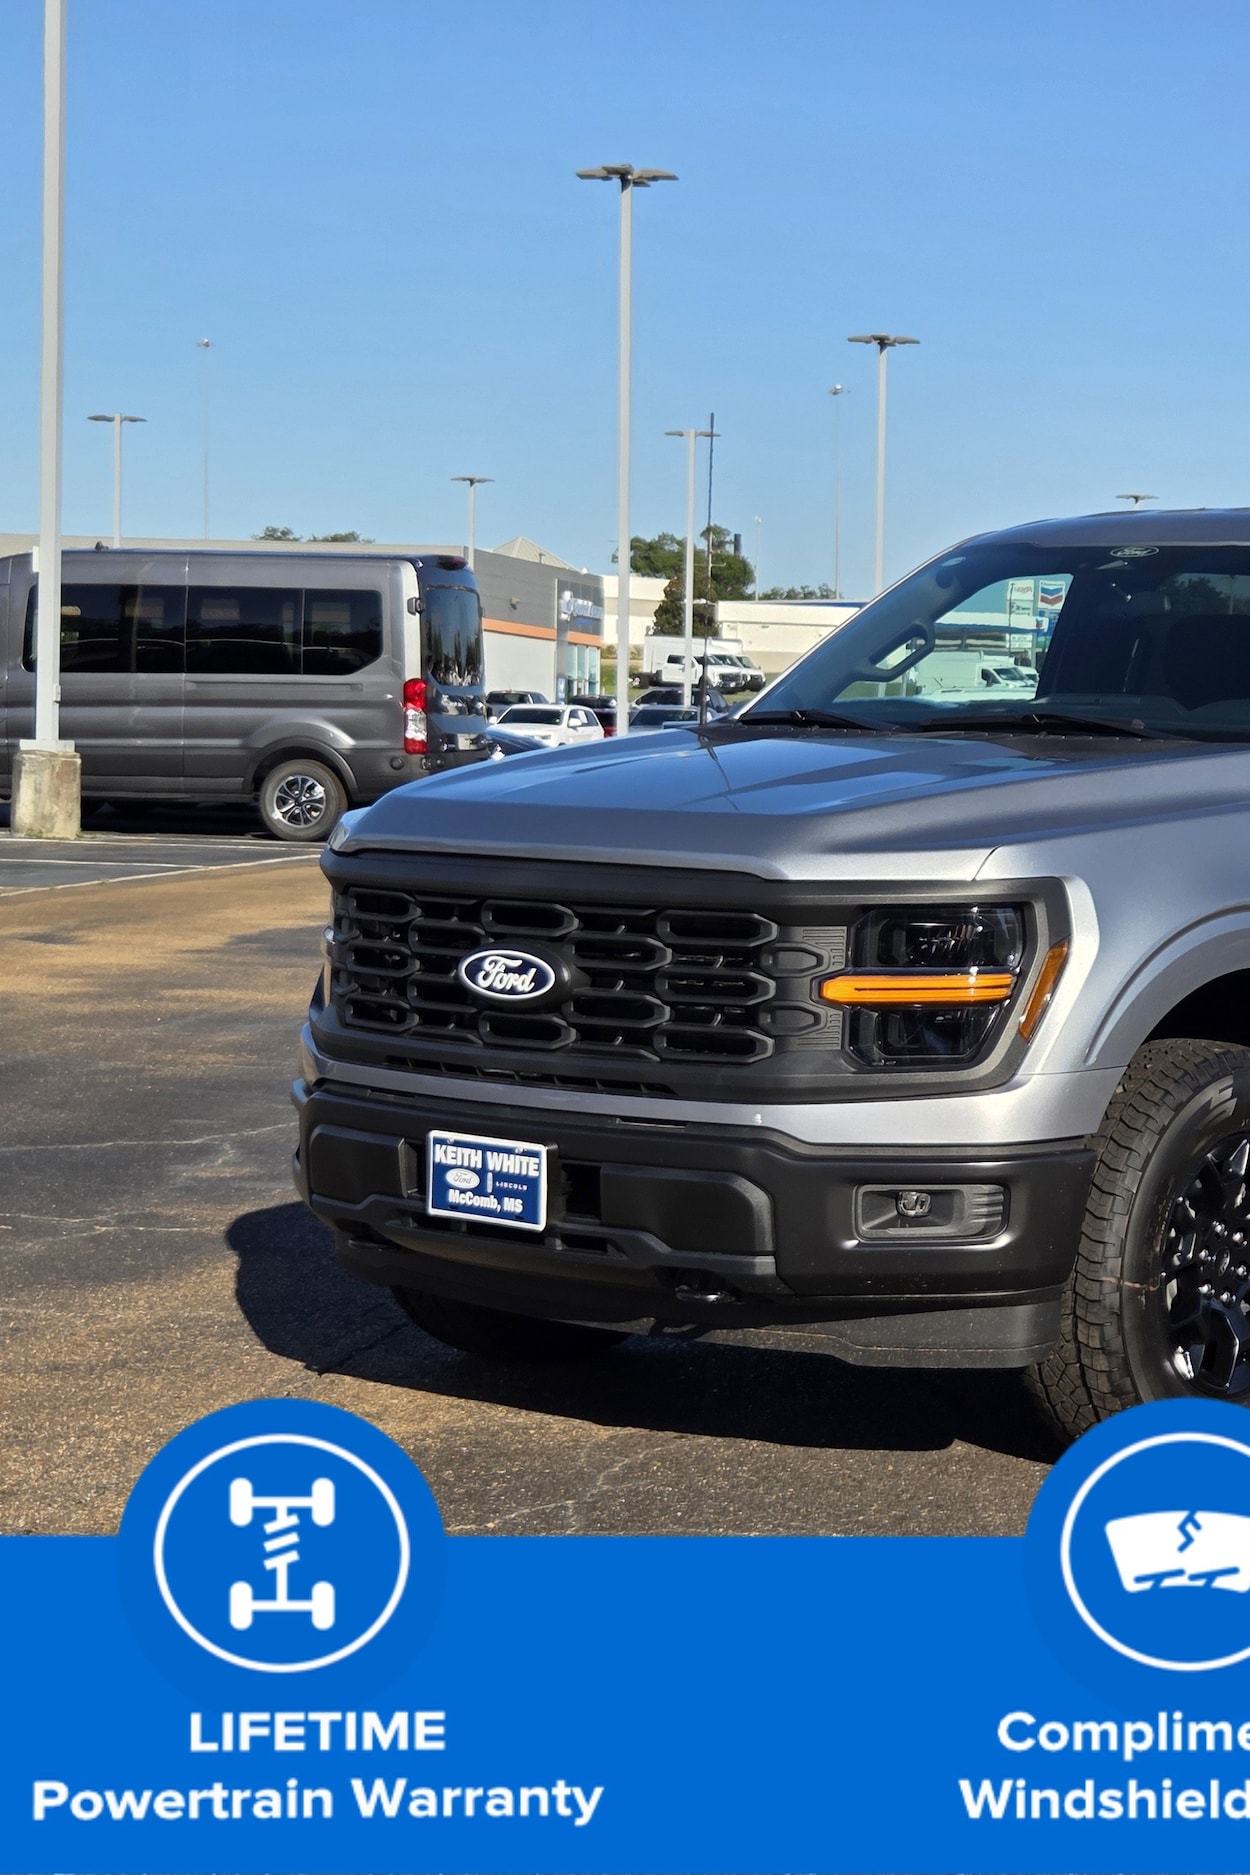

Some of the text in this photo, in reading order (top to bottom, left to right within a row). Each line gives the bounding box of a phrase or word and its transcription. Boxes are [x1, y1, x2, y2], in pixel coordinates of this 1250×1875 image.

[477, 955, 538, 993] Ford
[435, 1143, 540, 1178] KEITH WHITE
[453, 1171, 473, 1186] Ford
[449, 1189, 524, 1214] McComb, MS
